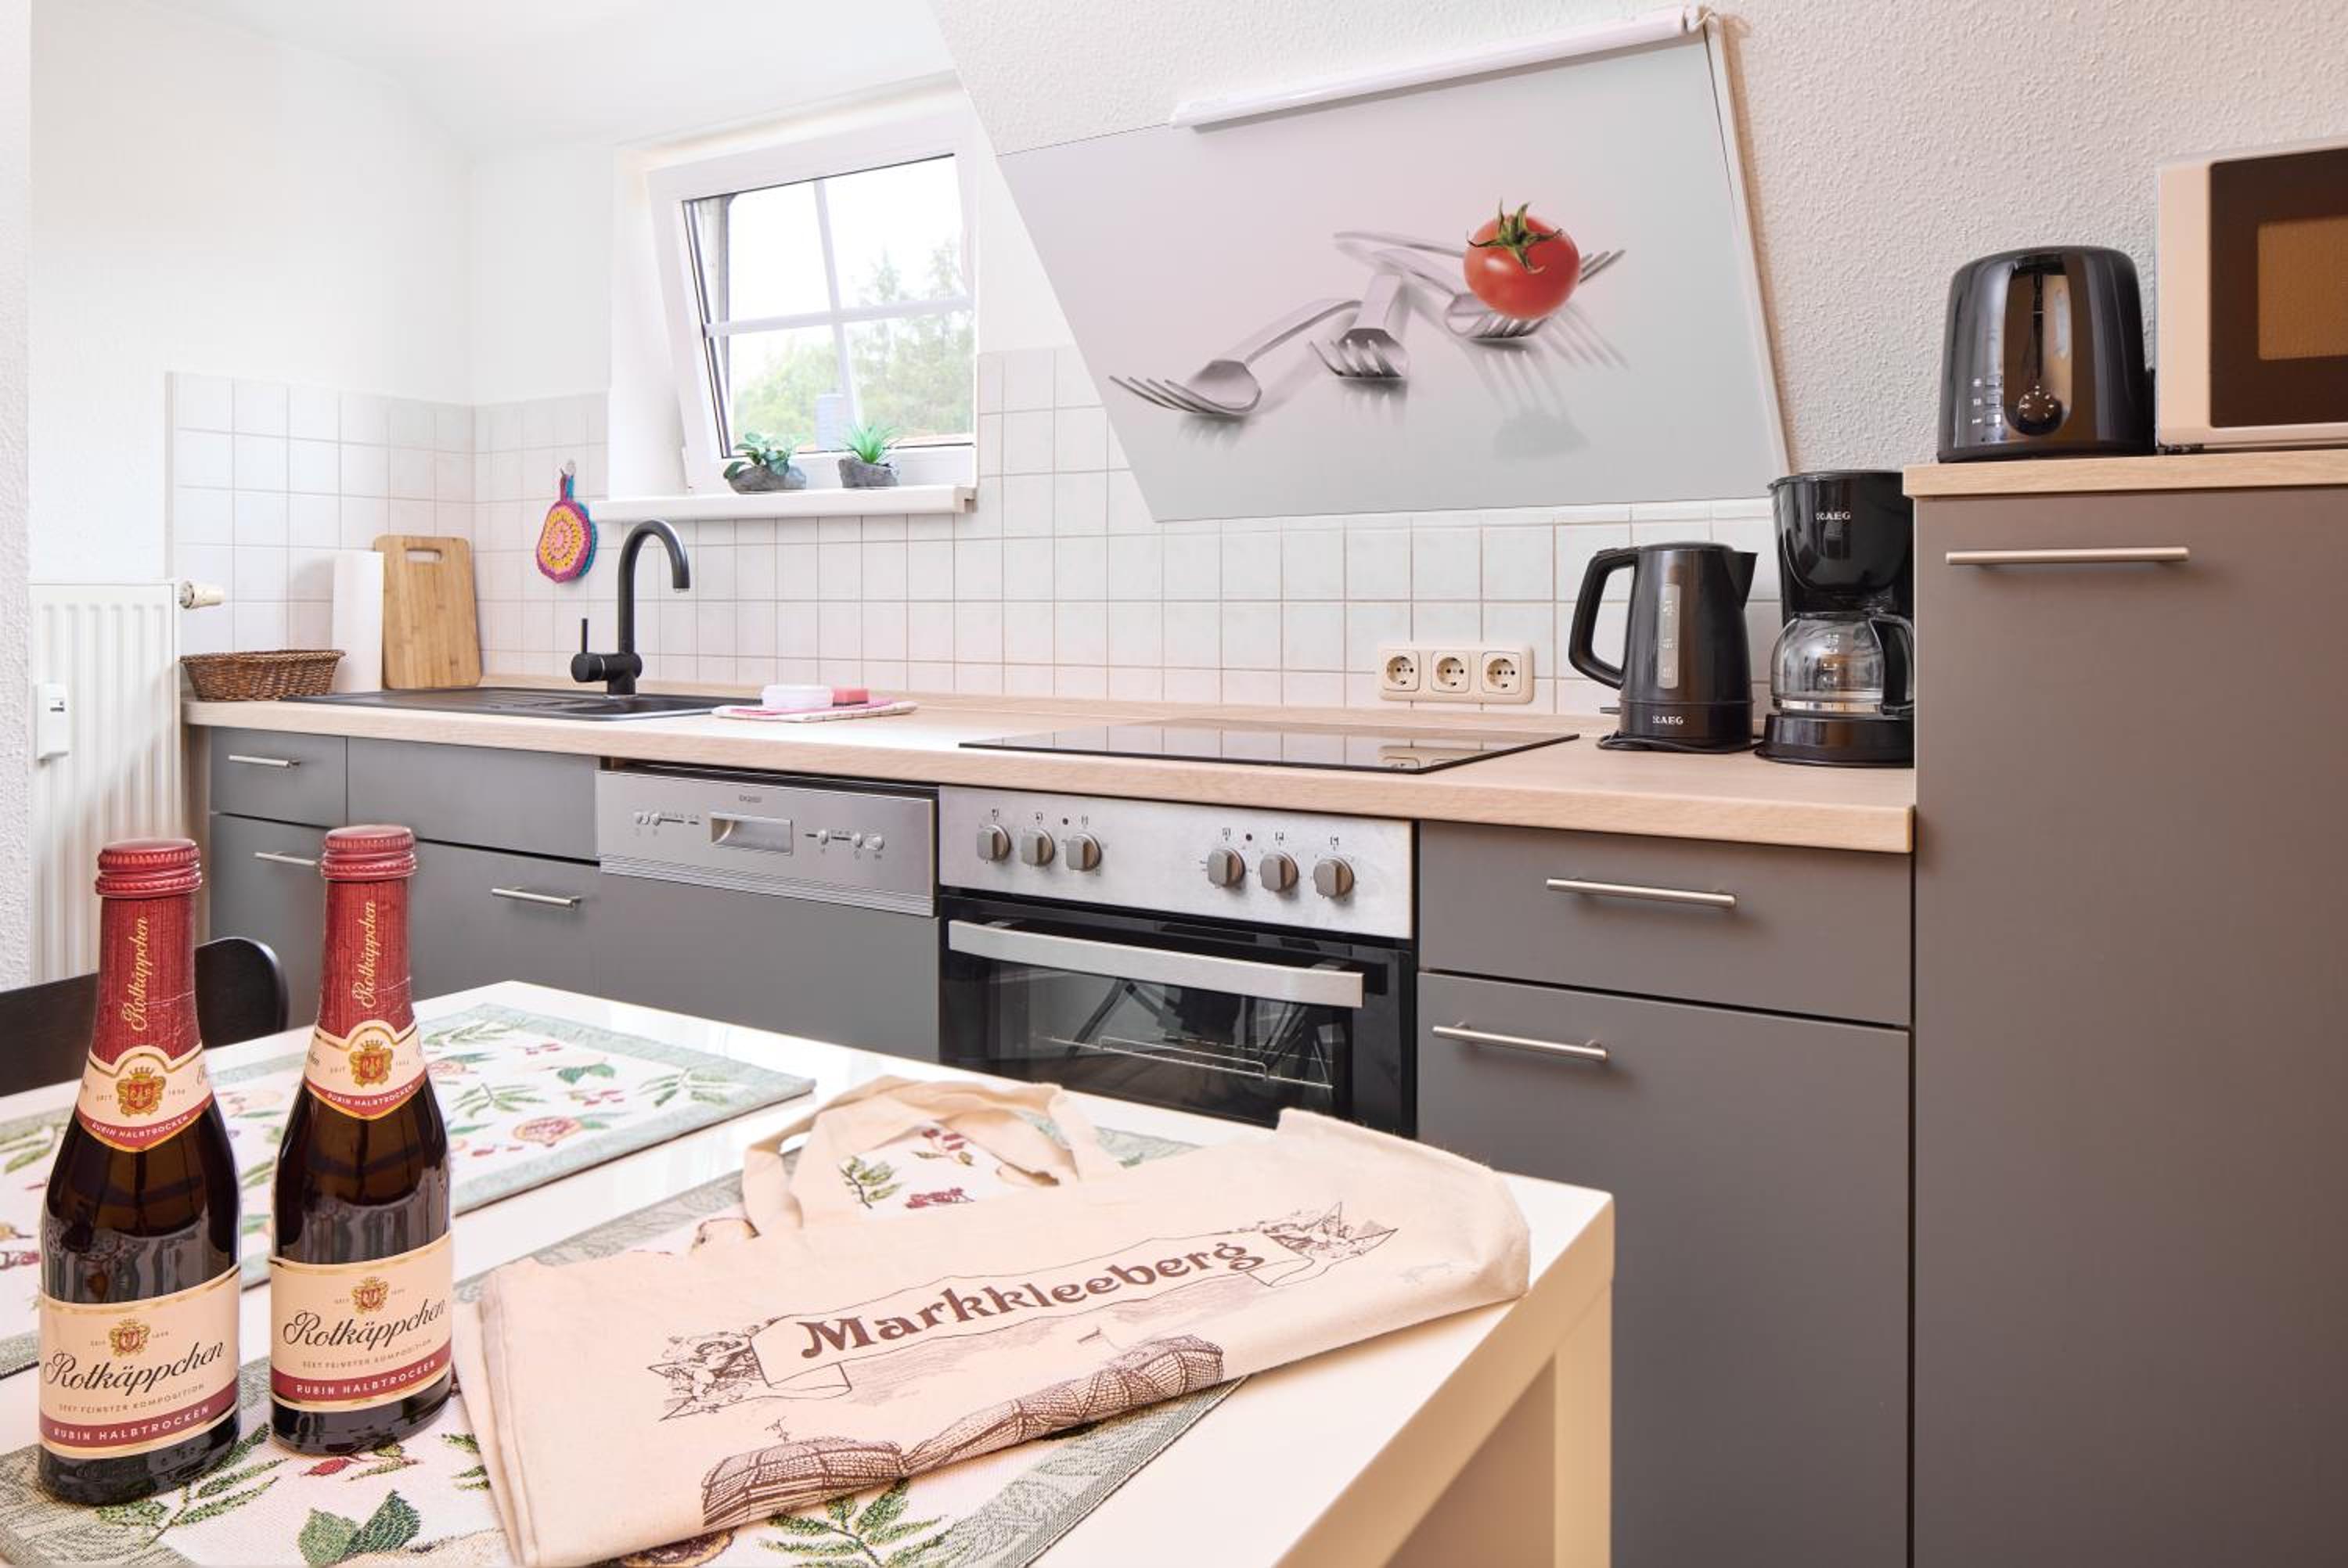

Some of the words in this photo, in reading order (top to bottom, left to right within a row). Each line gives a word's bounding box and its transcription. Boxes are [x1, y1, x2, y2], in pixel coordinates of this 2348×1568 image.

[1824, 511, 1851, 521] AEG
[1660, 715, 1684, 725] AEG
[121, 916, 153, 1032] Rotkäppchen
[351, 901, 381, 1009] Rotkäppchen
[283, 1297, 445, 1351] Rotkäppchen
[796, 1241, 1265, 1359] Markkleeberg
[43, 1339, 225, 1397] Rotkäppchen
[297, 1383, 335, 1395] RUBIN
[52, 1426, 92, 1441] RUBIN
[99, 1405, 210, 1441] HALBTROCKEN
